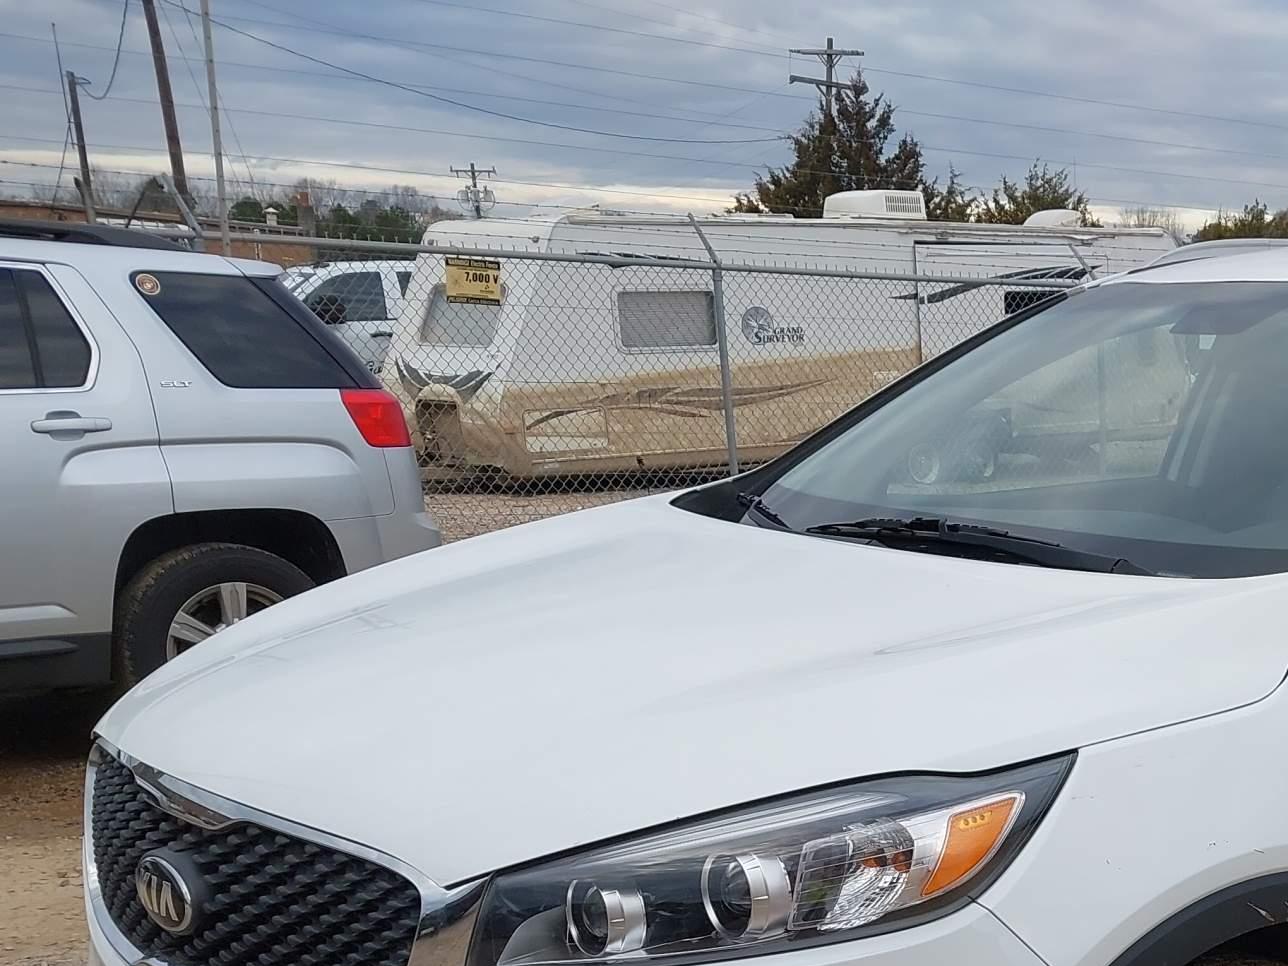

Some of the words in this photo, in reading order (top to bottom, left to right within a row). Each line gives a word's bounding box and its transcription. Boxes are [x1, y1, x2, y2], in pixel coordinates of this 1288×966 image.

[464, 271, 490, 284] 7,000
[492, 274, 499, 285] V
[773, 326, 804, 335] GRAND
[754, 331, 806, 344] SURVEYOR
[160, 380, 192, 388] SLT
